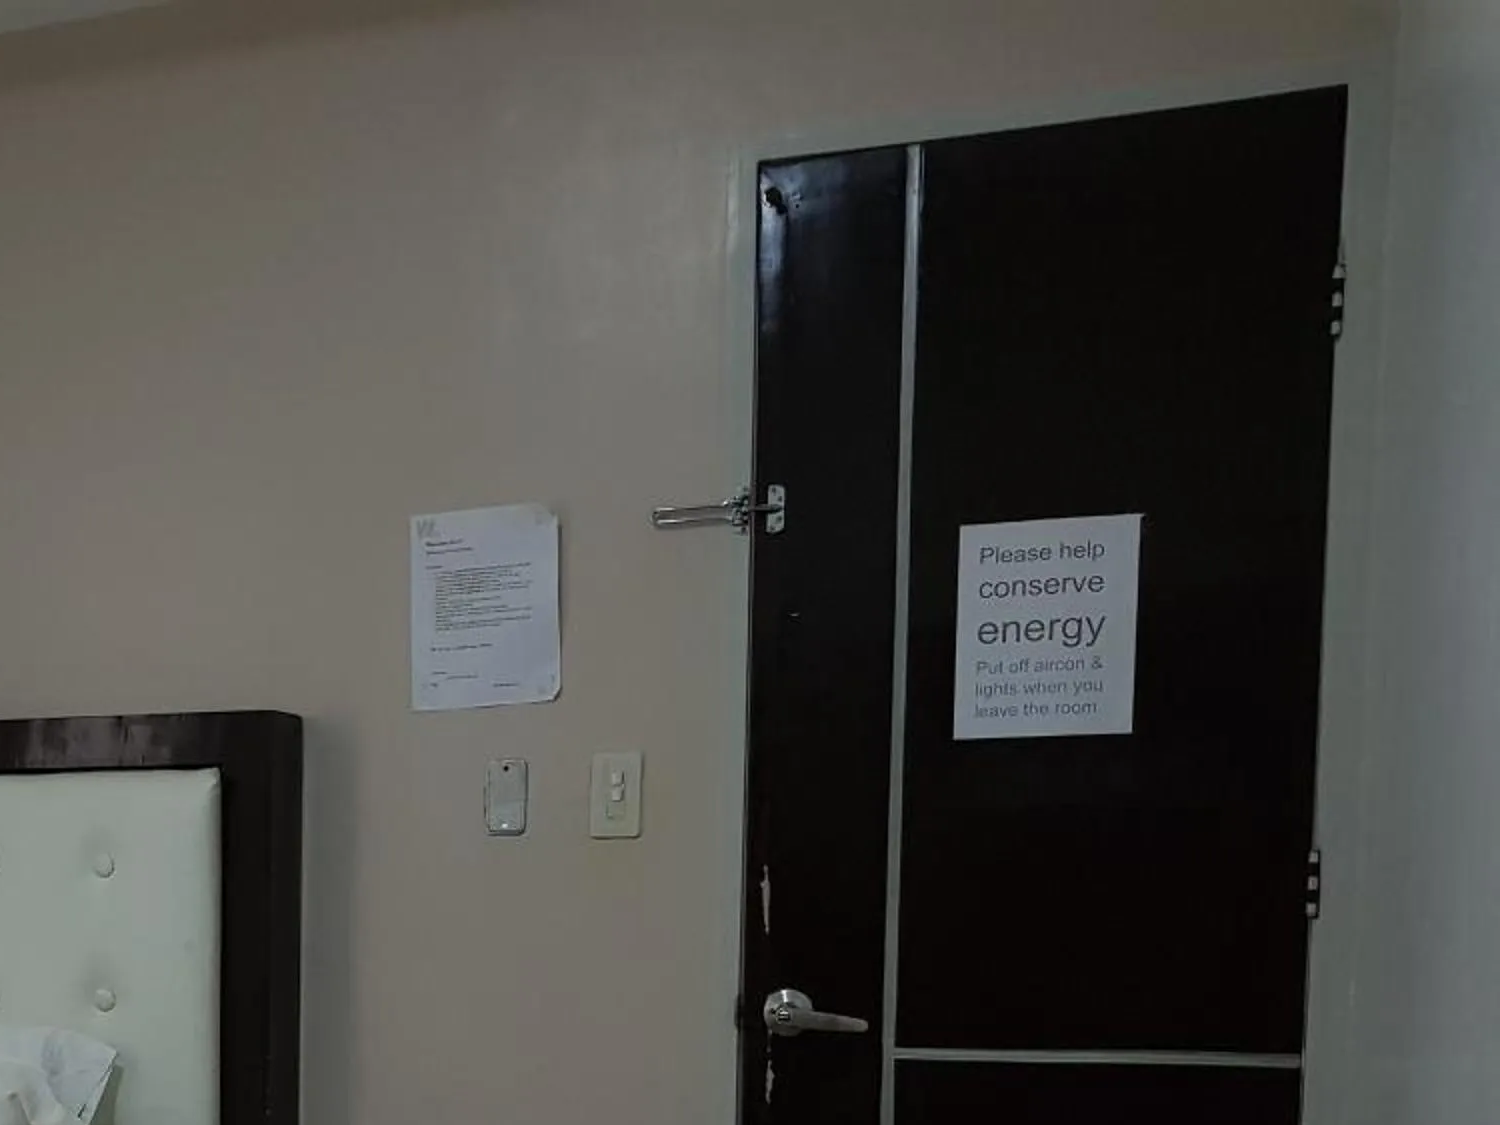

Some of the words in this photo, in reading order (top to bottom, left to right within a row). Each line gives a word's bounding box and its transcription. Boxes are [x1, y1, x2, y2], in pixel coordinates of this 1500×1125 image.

[979, 546, 1052, 564] Please
[1059, 539, 1105, 561] help
[979, 575, 1105, 598] conserve
[977, 615, 1106, 648] energy
[975, 660, 1003, 675] Put
[1008, 658, 1030, 674] off
[1033, 658, 1085, 673] aircon
[1091, 655, 1103, 669] &
[974, 681, 1018, 699] lights
[1023, 680, 1067, 696] when
[1072, 679, 1104, 697] you
[975, 703, 1018, 719] leave
[1023, 701, 1049, 717] the
